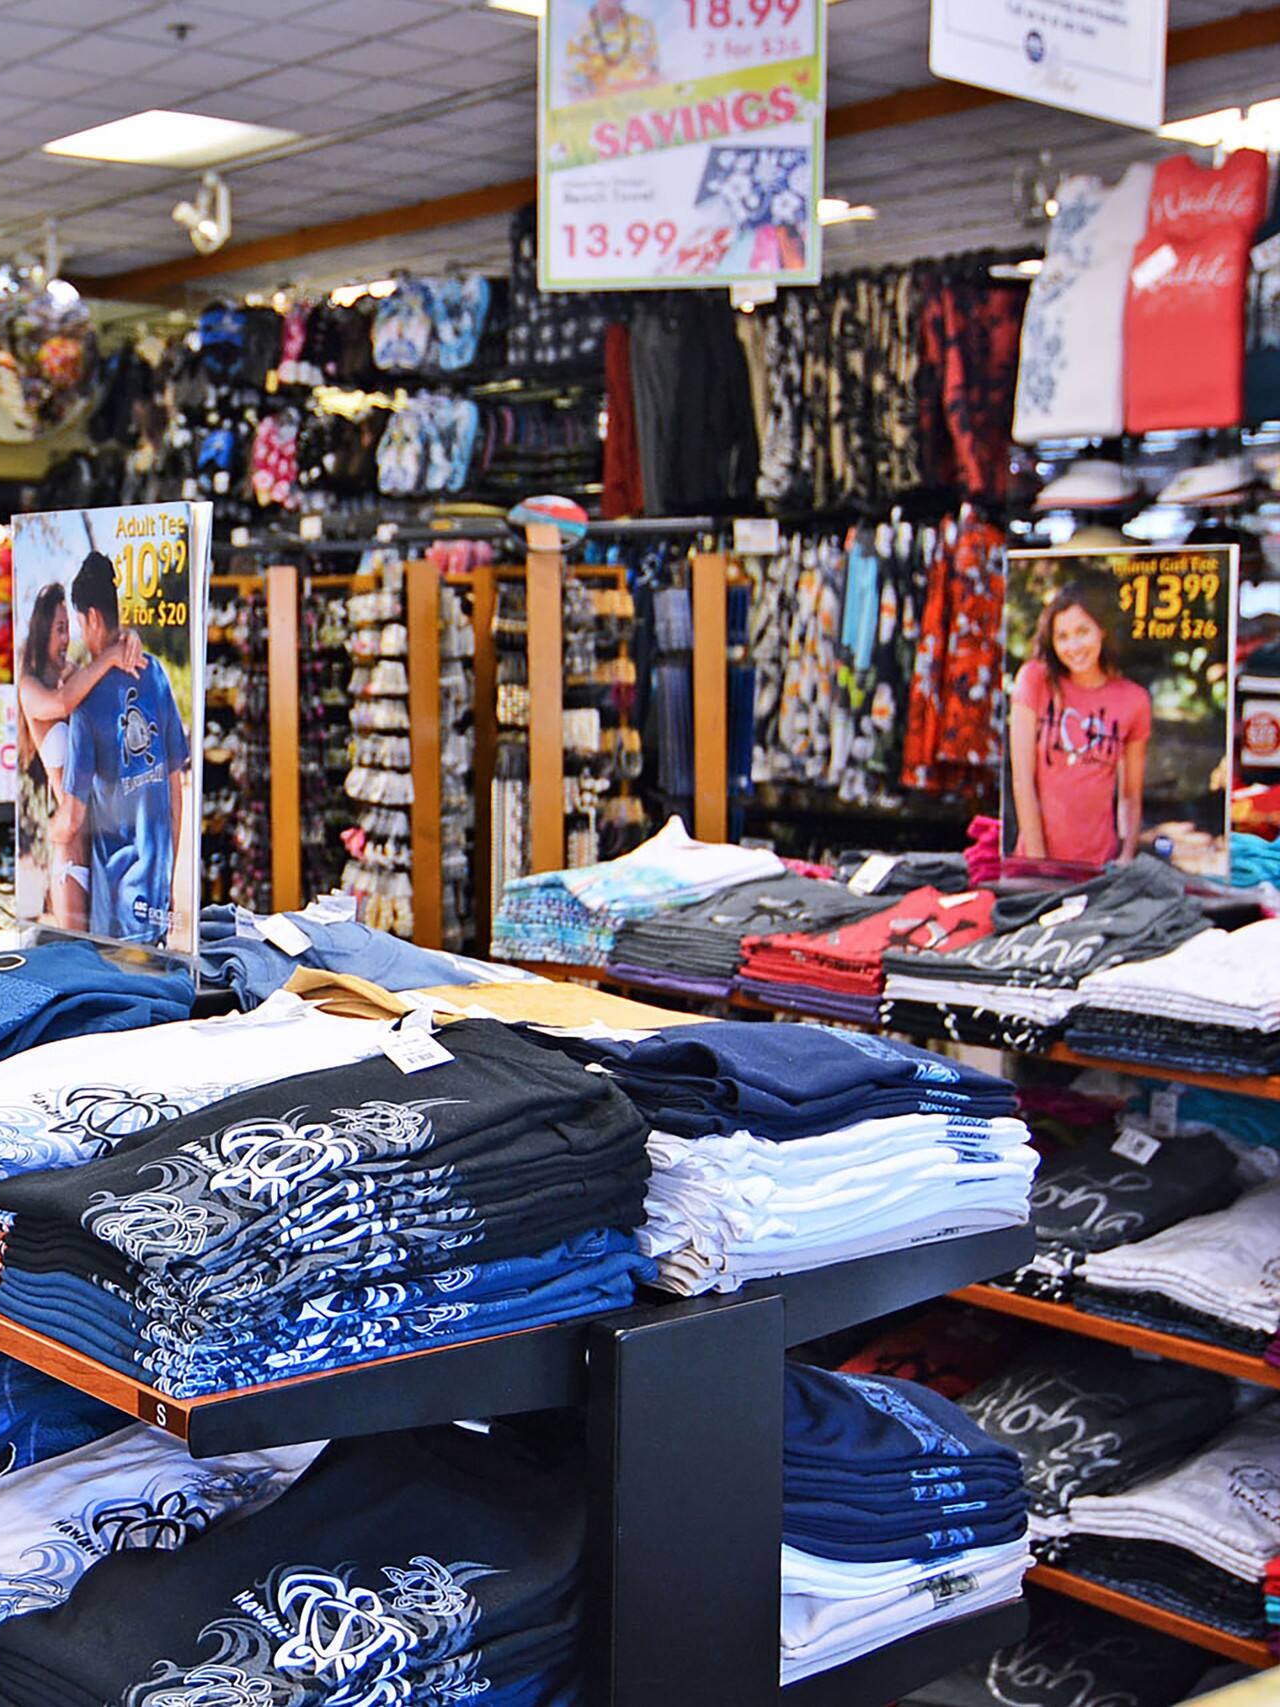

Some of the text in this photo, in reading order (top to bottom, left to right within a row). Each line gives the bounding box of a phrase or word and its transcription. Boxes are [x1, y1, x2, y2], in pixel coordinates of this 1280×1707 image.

[594, 85, 798, 159] SAVINGS
[562, 221, 677, 258] 13.99
[115, 512, 186, 538] Adult Tee
[120, 600, 187, 627] 2 for $20
[1132, 618, 1218, 640] 2 for $26
[156, 1402, 167, 1427] S
[231, 1589, 297, 1641] Hawaii
